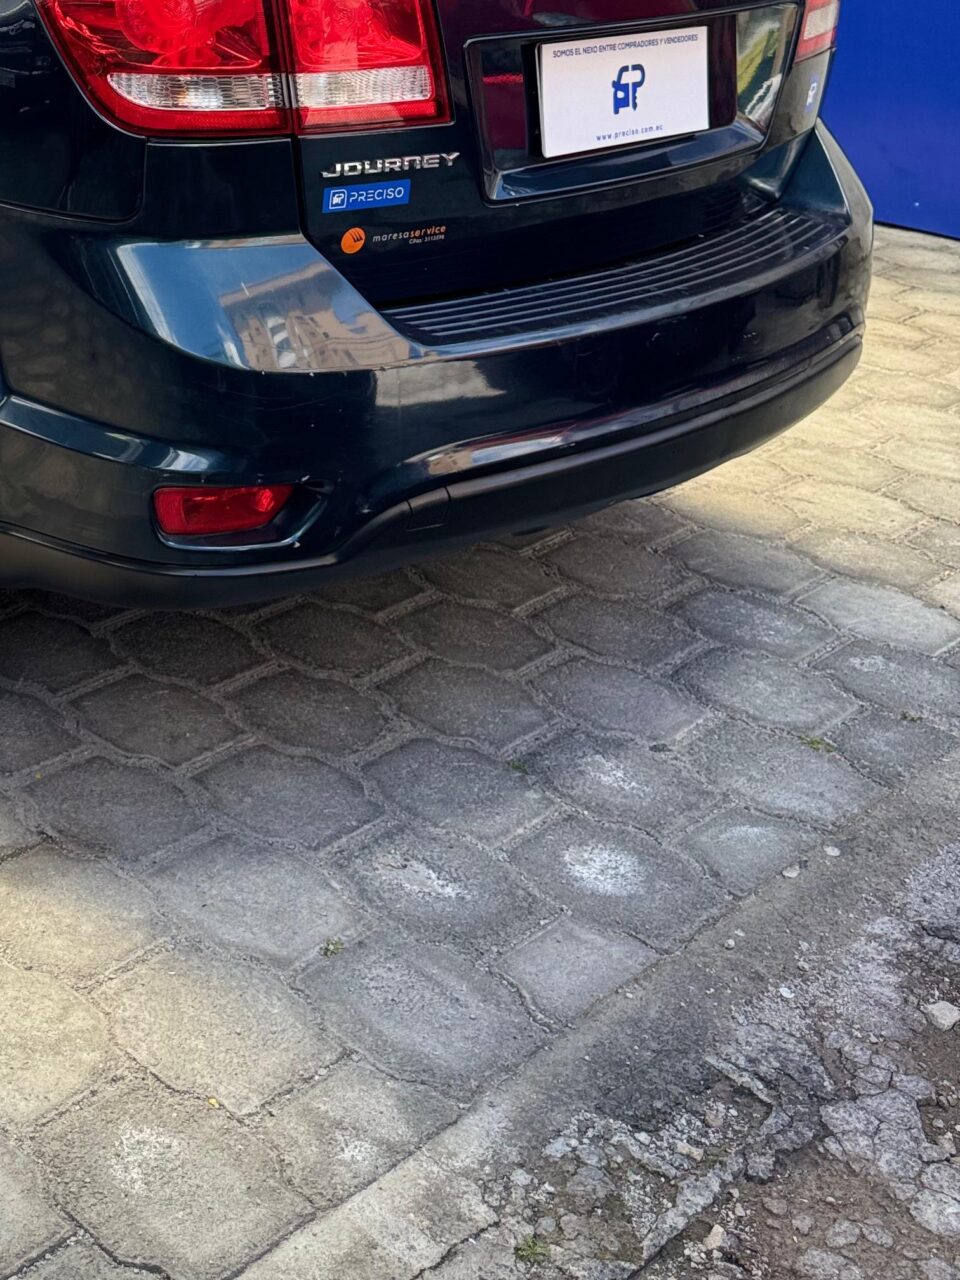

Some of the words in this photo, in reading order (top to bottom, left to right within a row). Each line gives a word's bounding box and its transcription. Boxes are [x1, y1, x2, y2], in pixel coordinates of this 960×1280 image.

[552, 48, 574, 58] SOMOS
[575, 48, 582, 56] EL
[583, 45, 598, 55] NEXO
[599, 43, 617, 53] ENTRE
[618, 38, 659, 51] COMPRADORES
[664, 34, 698, 45] VENDEDORES
[596, 124, 663, 142] www.preciso.com.ec
[321, 152, 460, 178] JOURNEY
[349, 187, 404, 203] PRECISO
